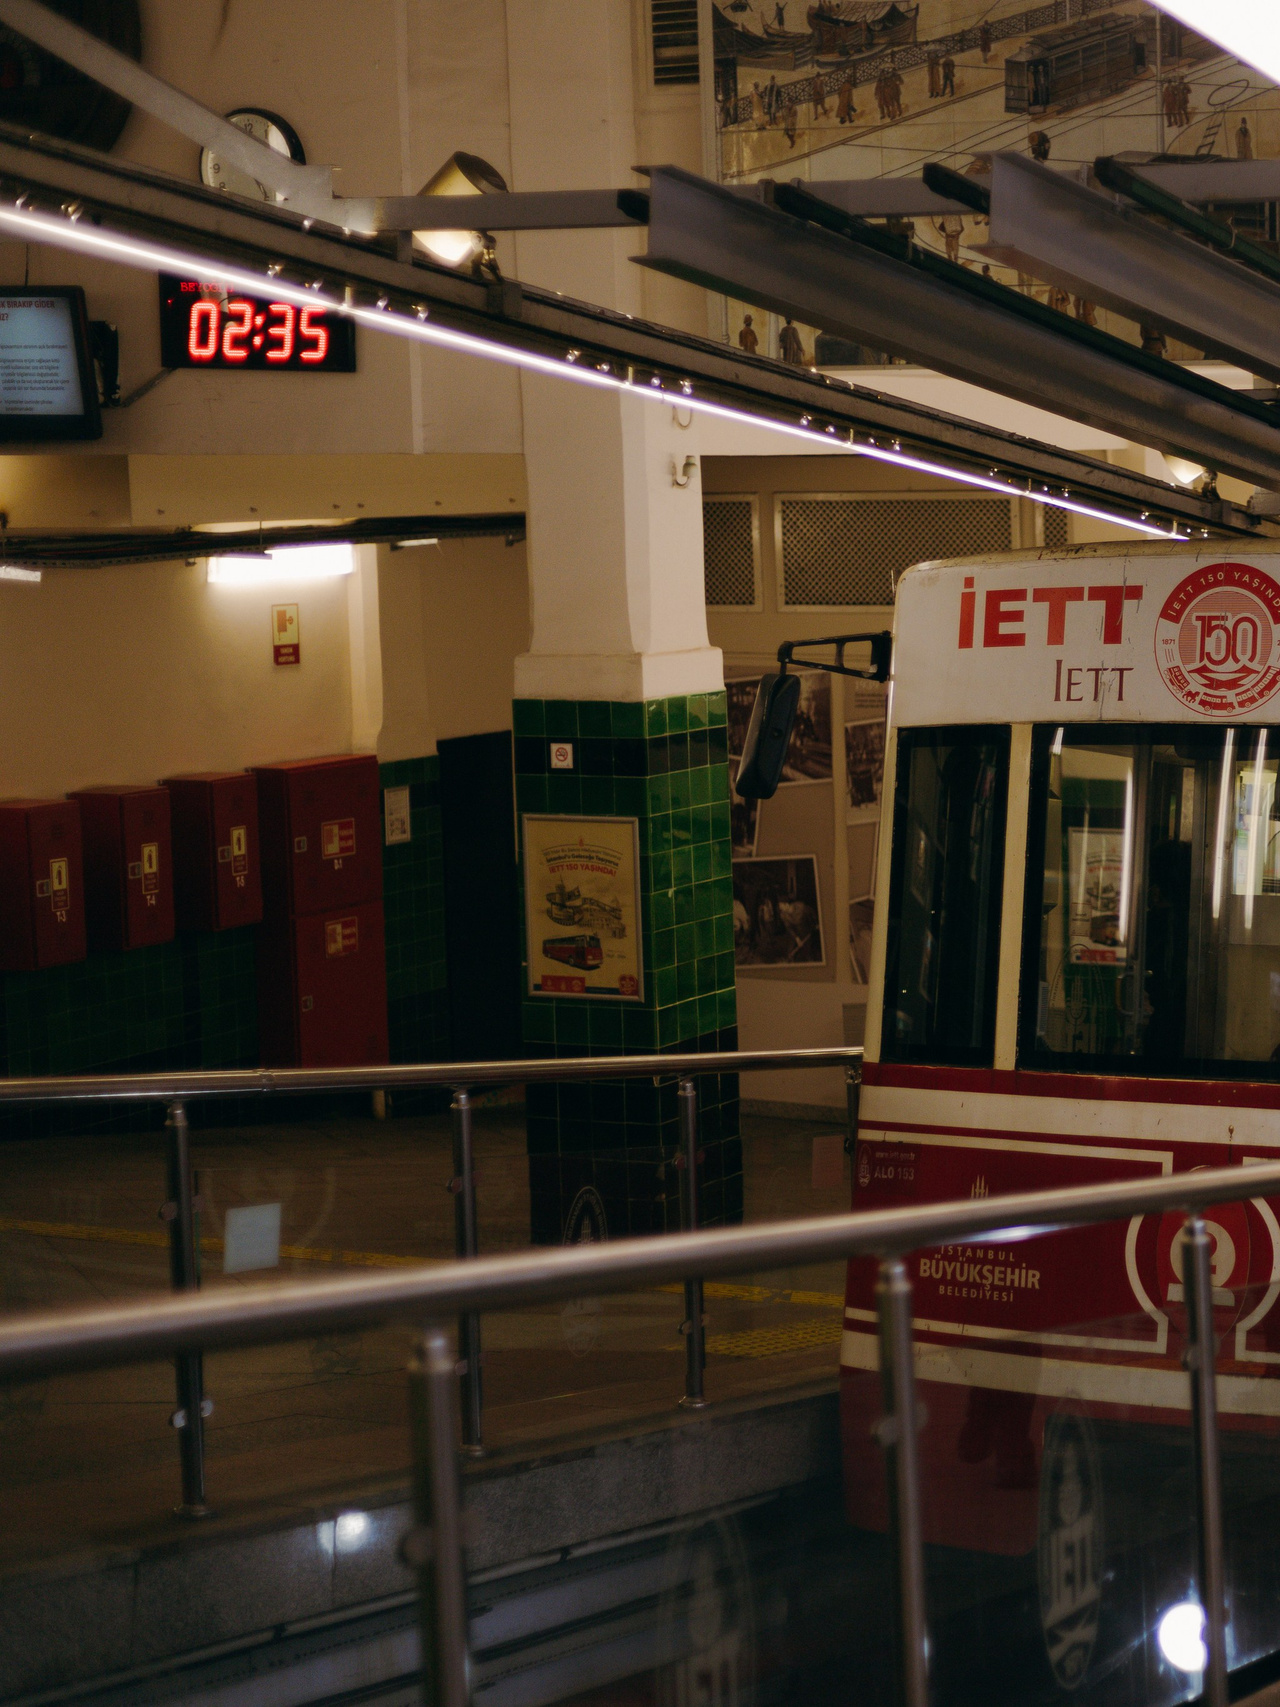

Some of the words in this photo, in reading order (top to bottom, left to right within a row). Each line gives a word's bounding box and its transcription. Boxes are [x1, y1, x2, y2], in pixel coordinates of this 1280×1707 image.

[188, 302, 329, 360] 02:35
[1168, 585, 1194, 617] İETT
[1200, 571, 1224, 586] 150
[958, 576, 1144, 649] İETT
[1194, 615, 1259, 667] 150
[1161, 638, 1176, 646] 1871
[874, 1166, 895, 1179] ALO
[897, 1167, 915, 1181] 153
[919, 1253, 1041, 1290] BÜYÜKŞEHİR
[939, 1285, 1014, 1302] BELEDİYESİ
